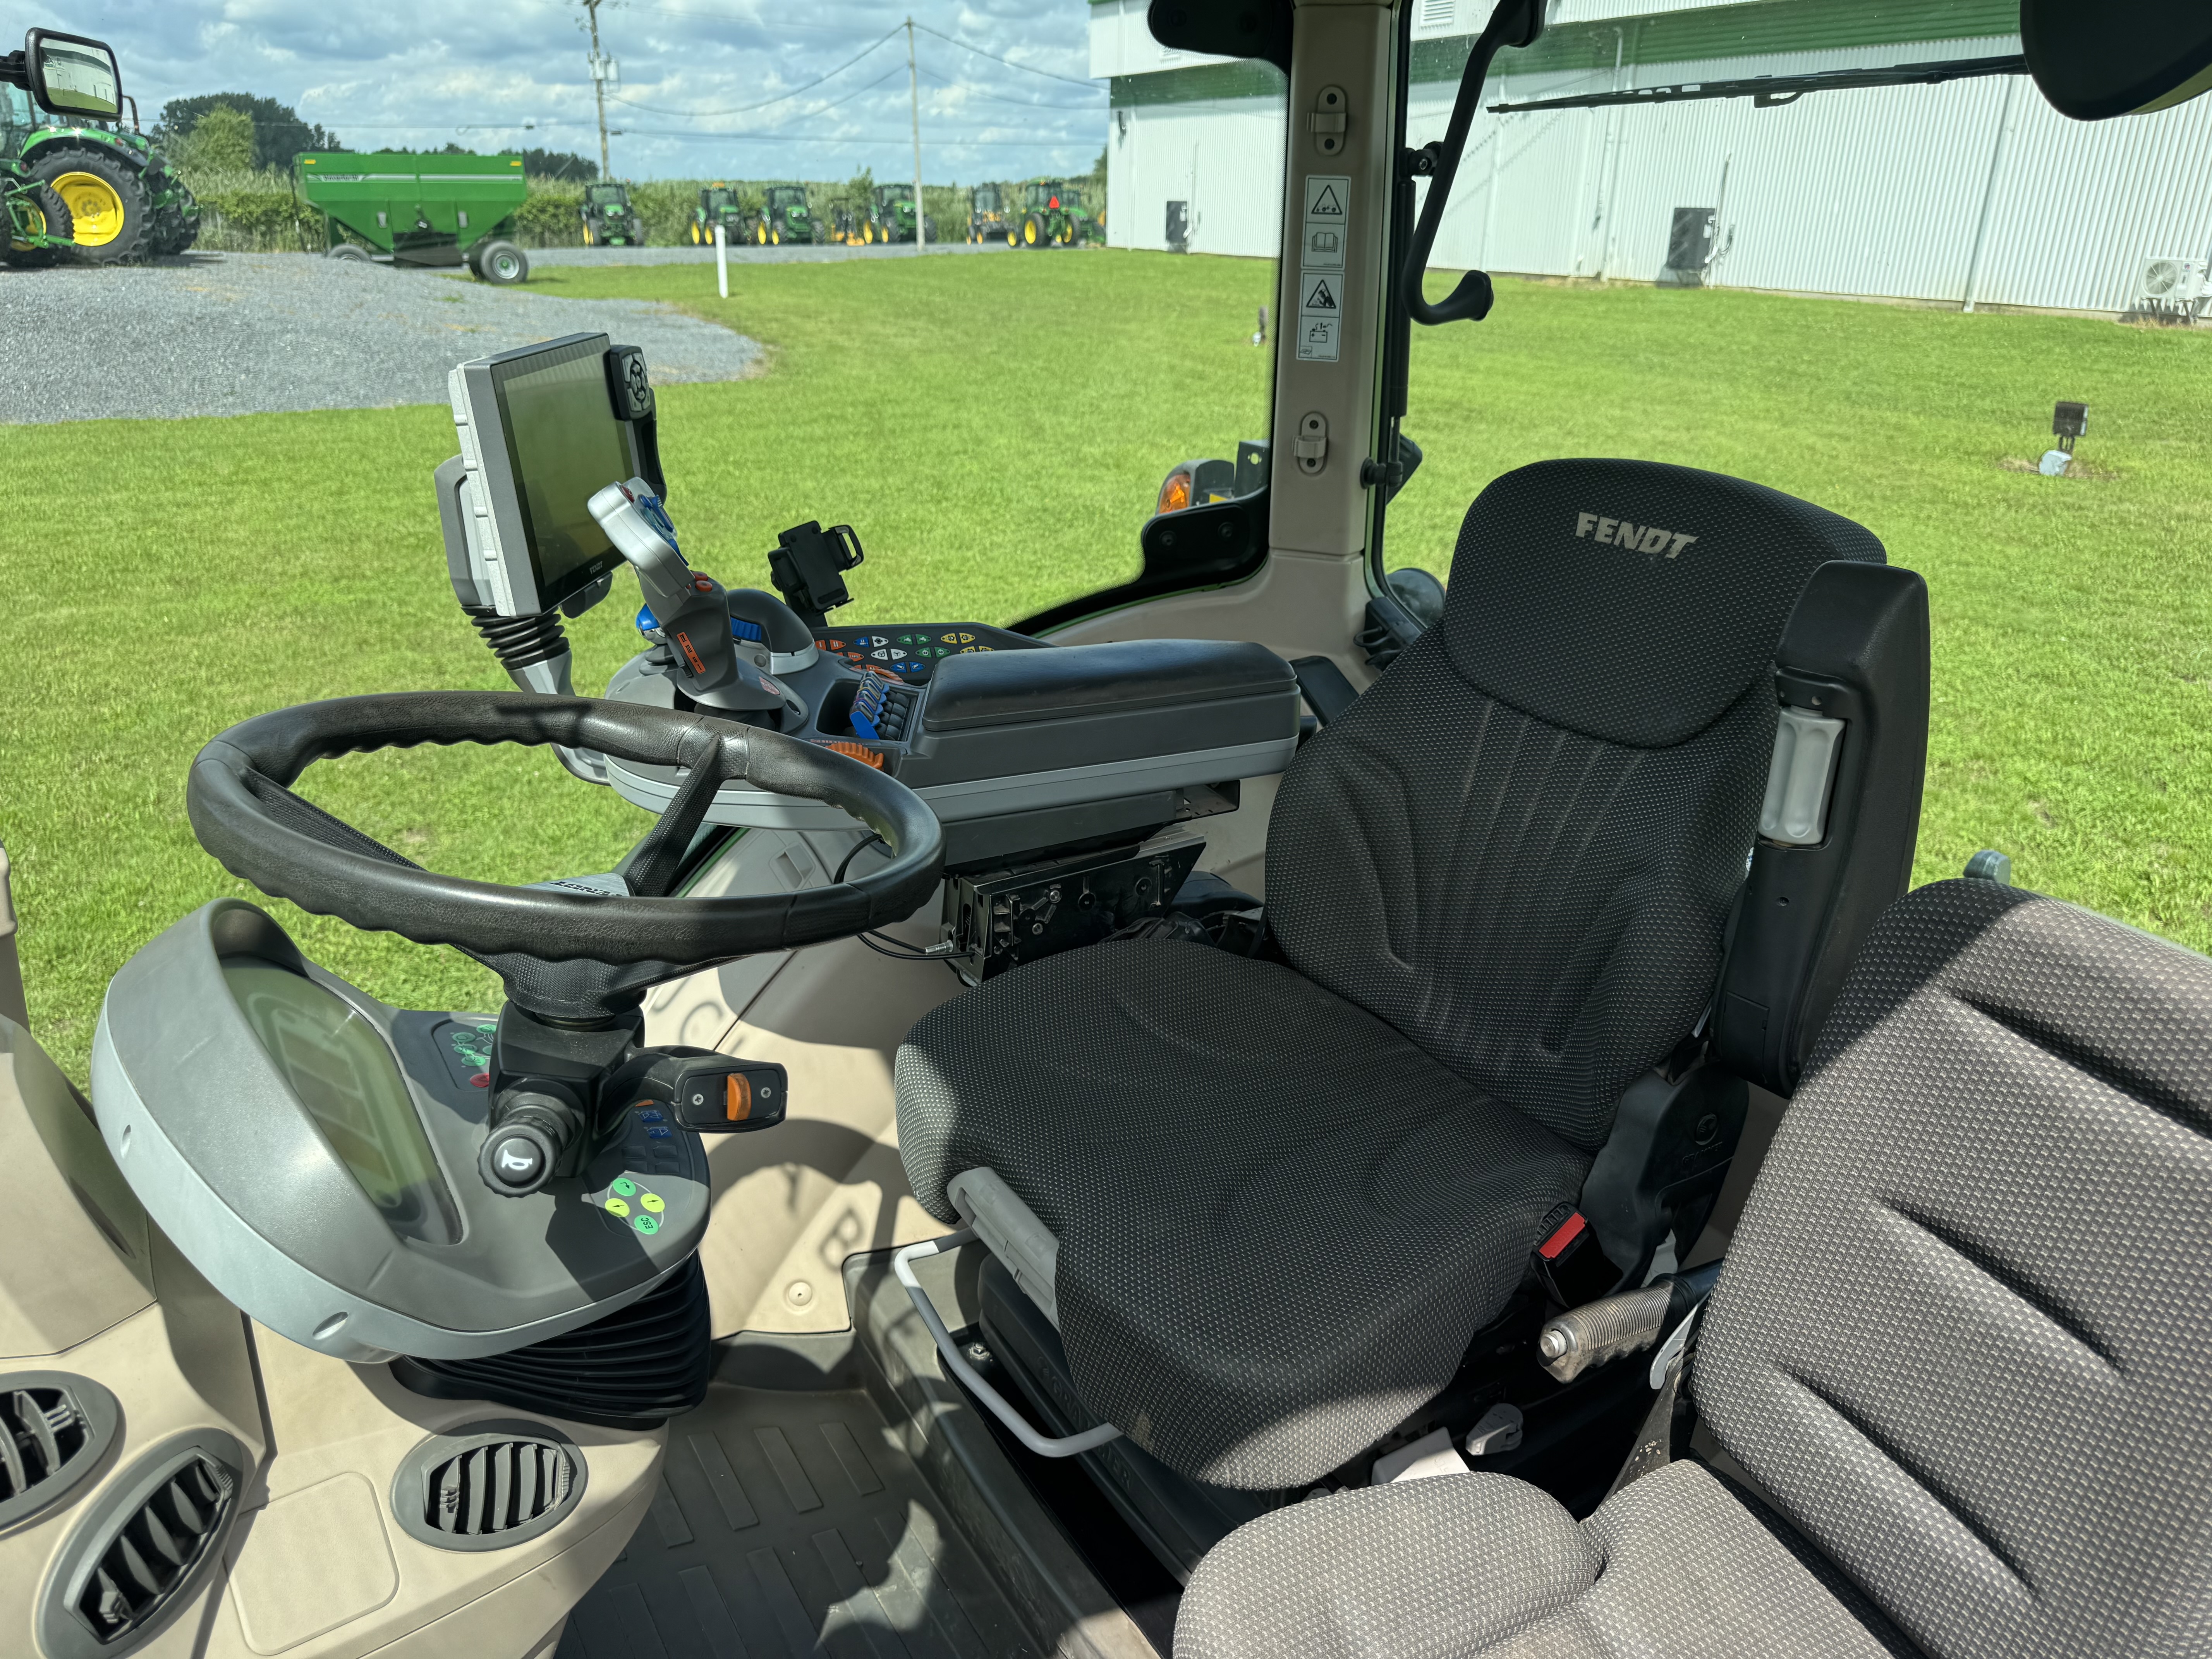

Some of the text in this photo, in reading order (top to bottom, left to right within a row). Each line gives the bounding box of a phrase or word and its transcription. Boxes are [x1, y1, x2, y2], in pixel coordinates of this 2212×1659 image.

[1575, 512, 1699, 560] FENDT
[589, 560, 603, 574] FENDT
[641, 1218, 654, 1229] ESC
